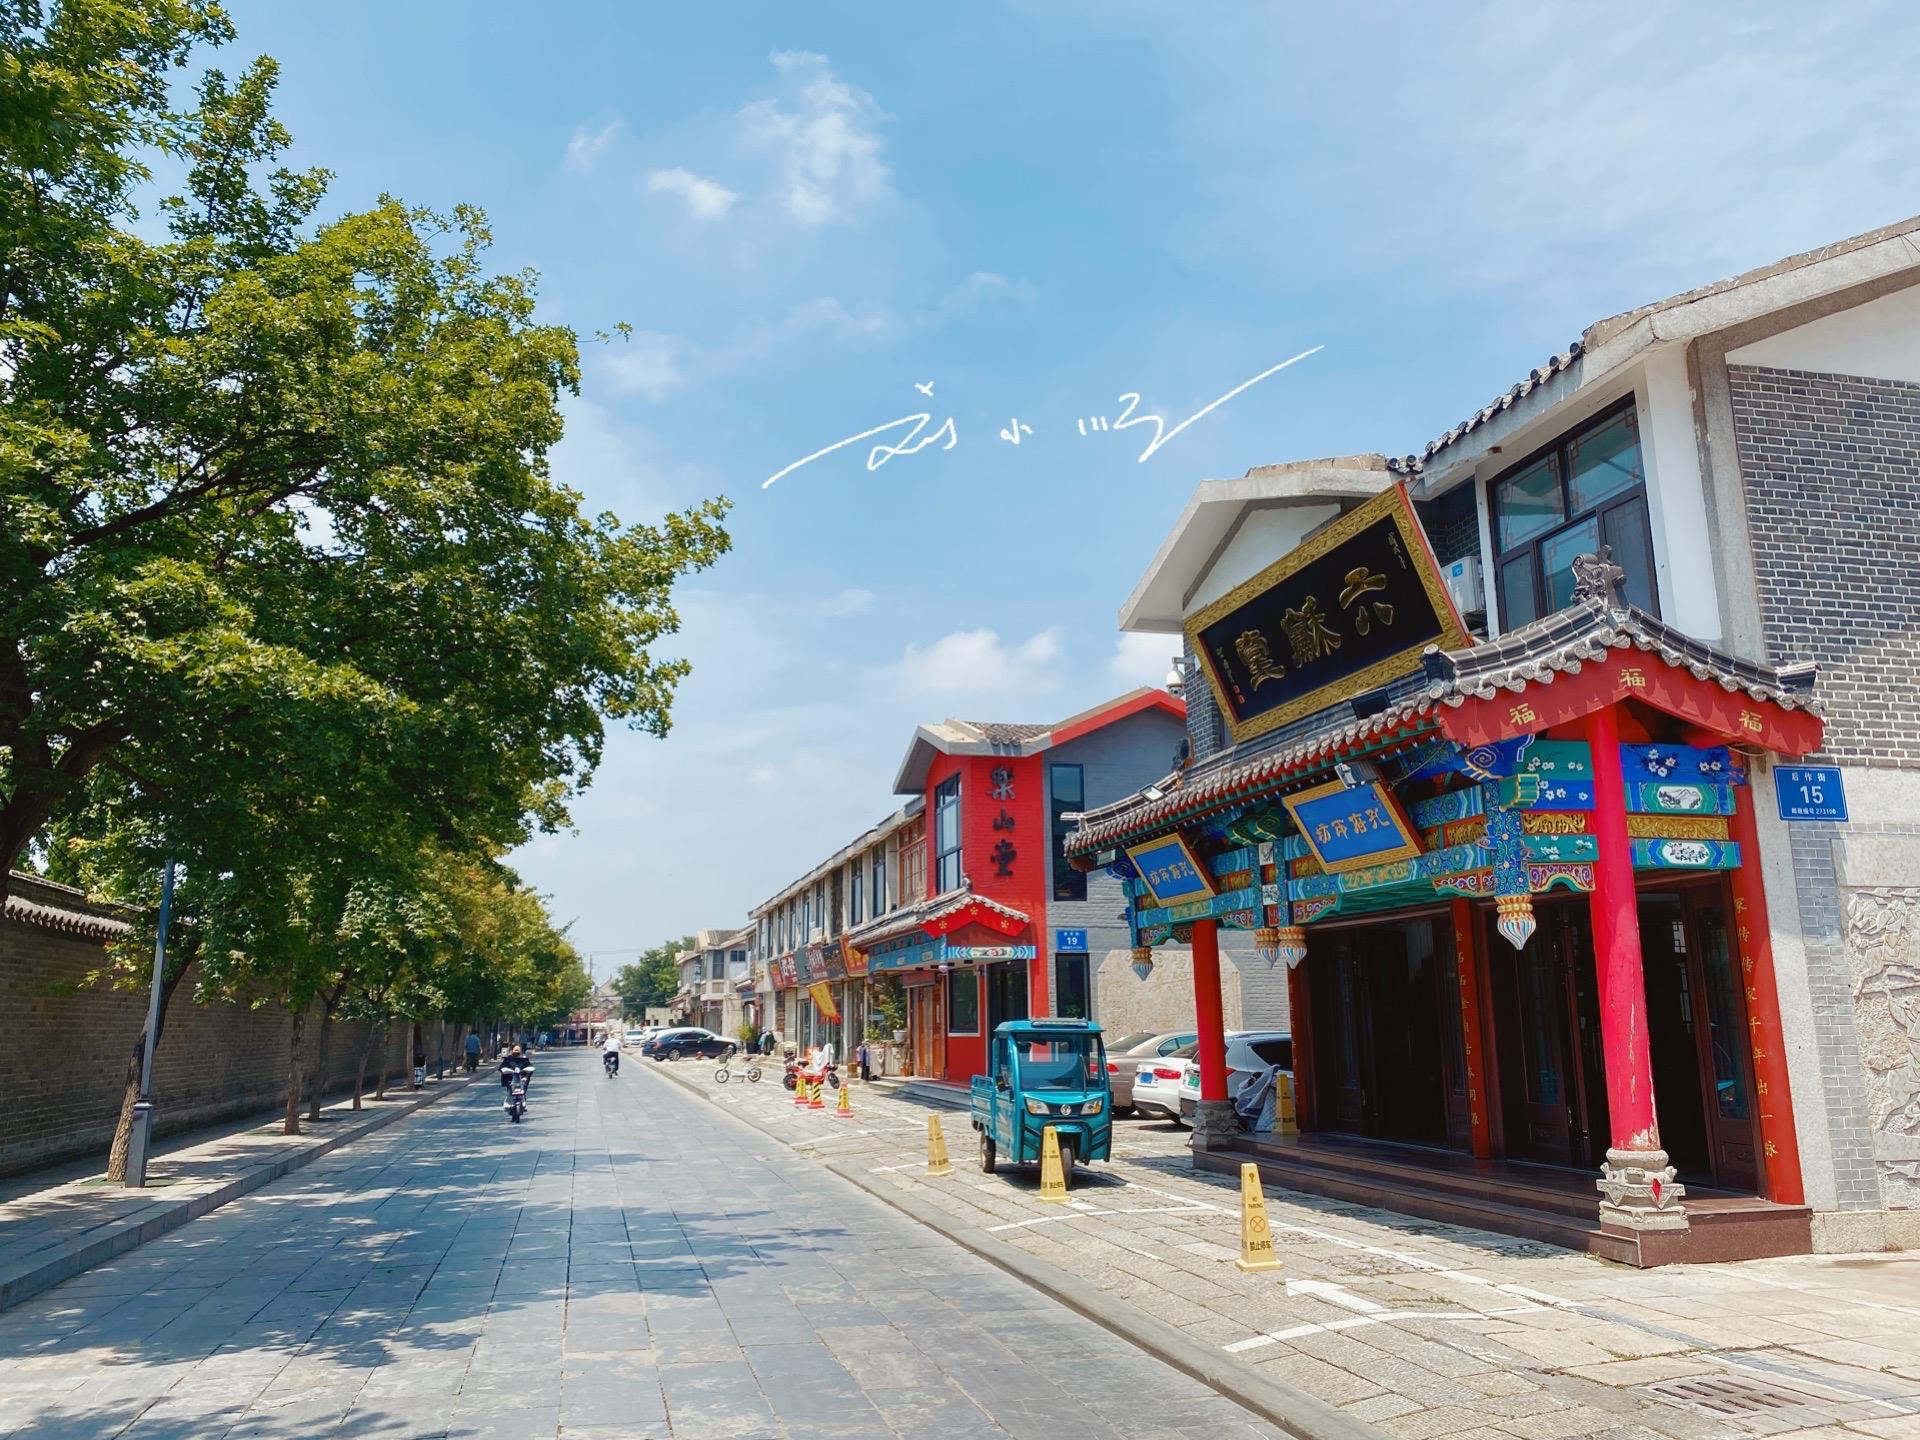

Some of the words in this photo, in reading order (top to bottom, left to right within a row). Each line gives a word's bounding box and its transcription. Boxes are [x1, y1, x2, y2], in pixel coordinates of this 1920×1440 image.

[1619, 668, 1646, 688] 福
[1509, 702, 1536, 725] 福
[1738, 709, 1763, 733] 福
[1799, 785, 1824, 804] 15
[1066, 937, 1078, 945] 19
[1249, 1240, 1272, 1251] 禁止停车
